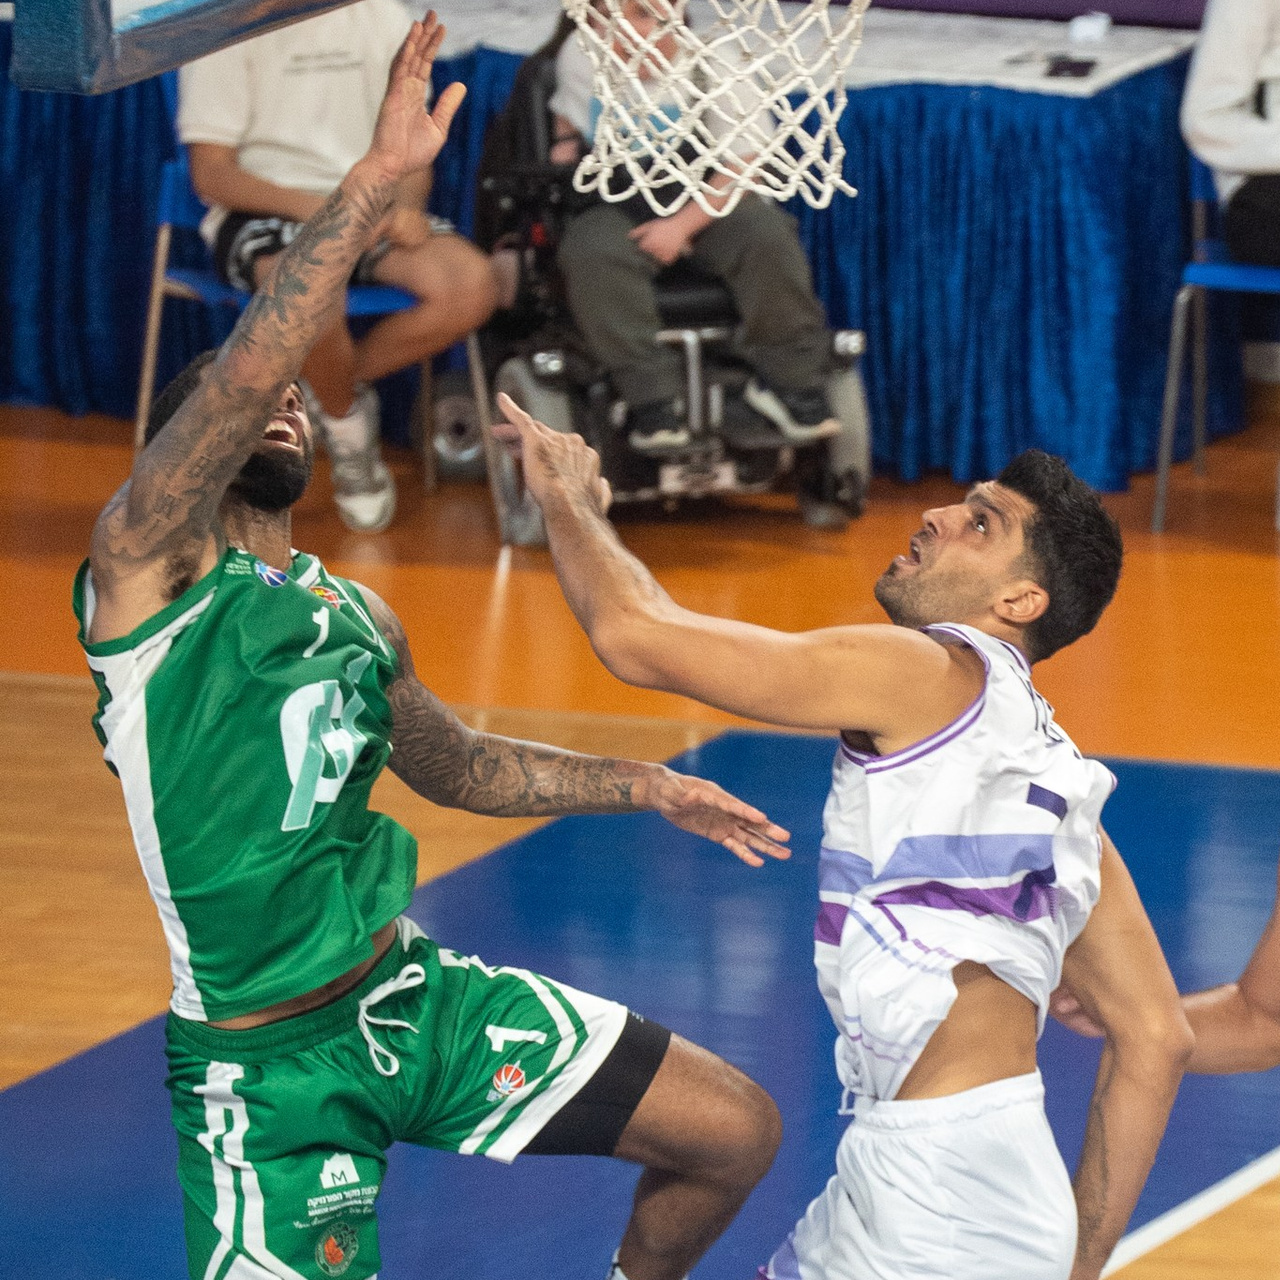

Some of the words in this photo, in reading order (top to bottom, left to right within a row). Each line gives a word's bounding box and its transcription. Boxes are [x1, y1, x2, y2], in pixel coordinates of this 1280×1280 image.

[302, 606, 330, 658] 1
[485, 1024, 547, 1053] 1
[331, 1170, 348, 1186] M
